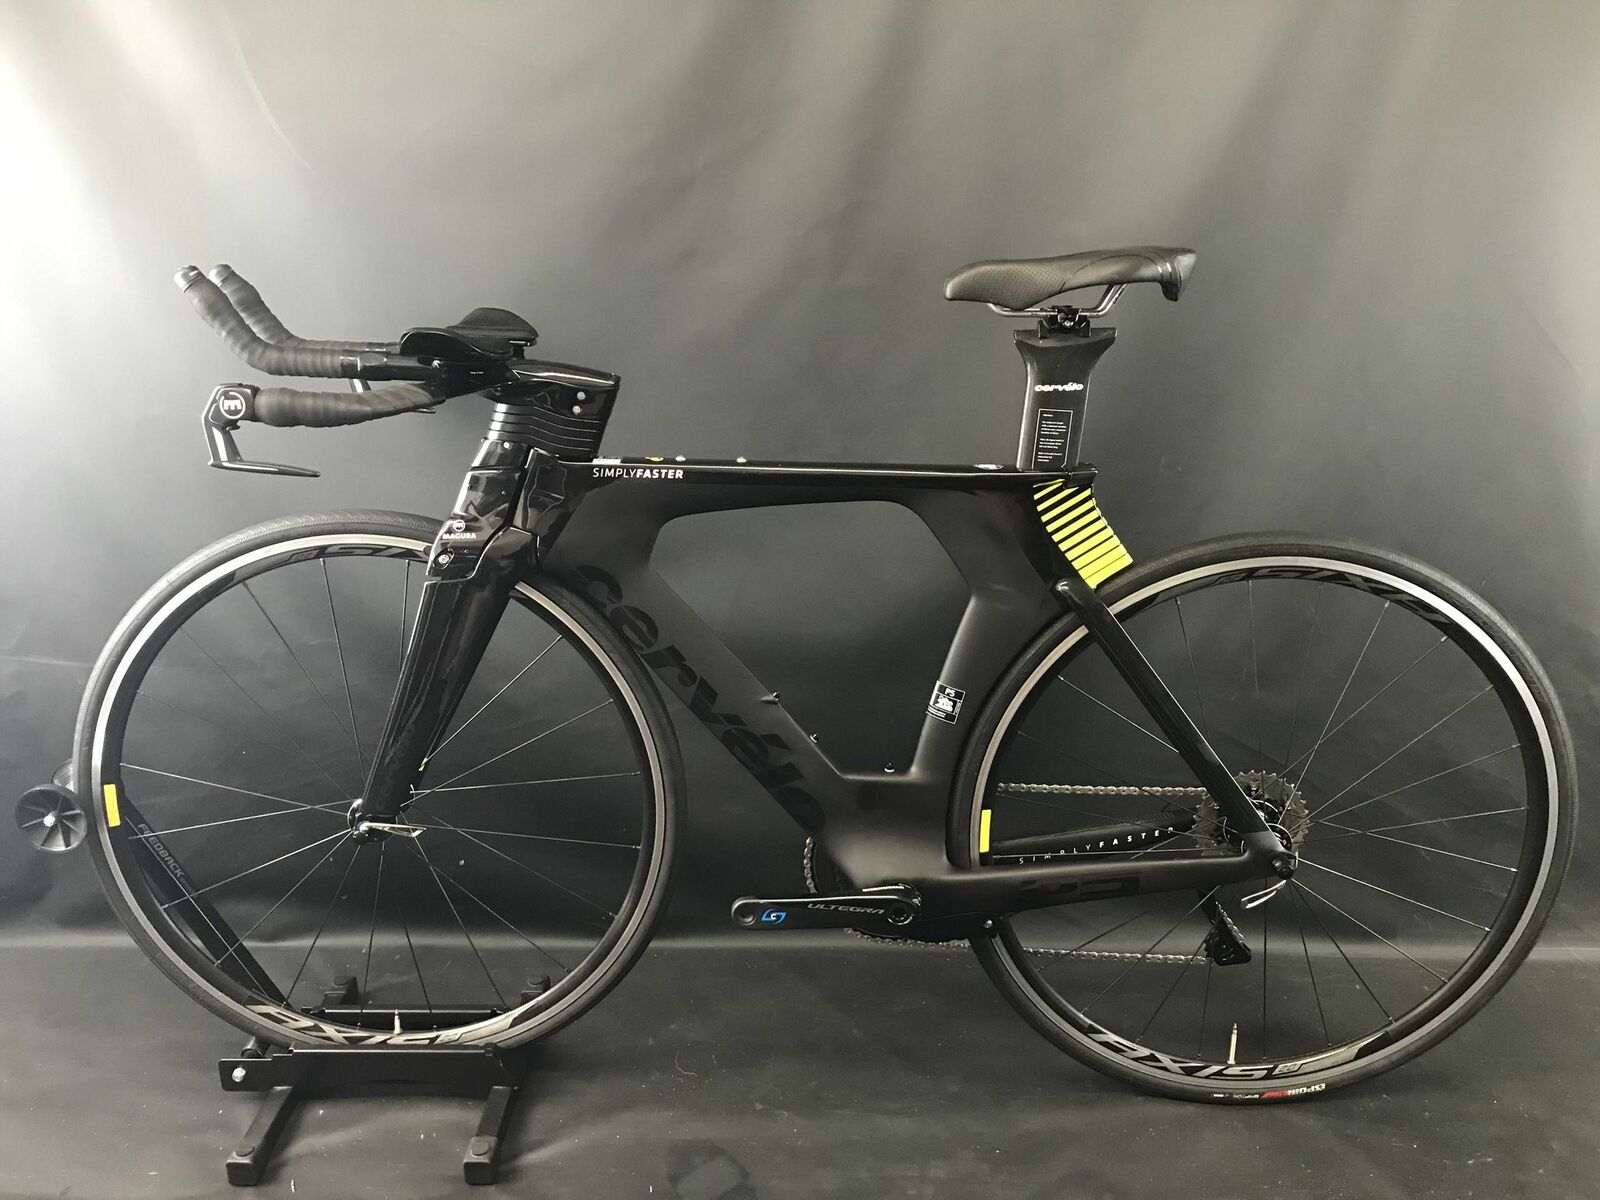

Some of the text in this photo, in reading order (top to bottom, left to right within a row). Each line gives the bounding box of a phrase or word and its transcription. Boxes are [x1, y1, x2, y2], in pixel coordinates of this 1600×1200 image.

[592, 467, 684, 479] SIMPLYFASTER
[442, 532, 477, 540] MAGURA
[807, 902, 885, 915] ULTEGRA
